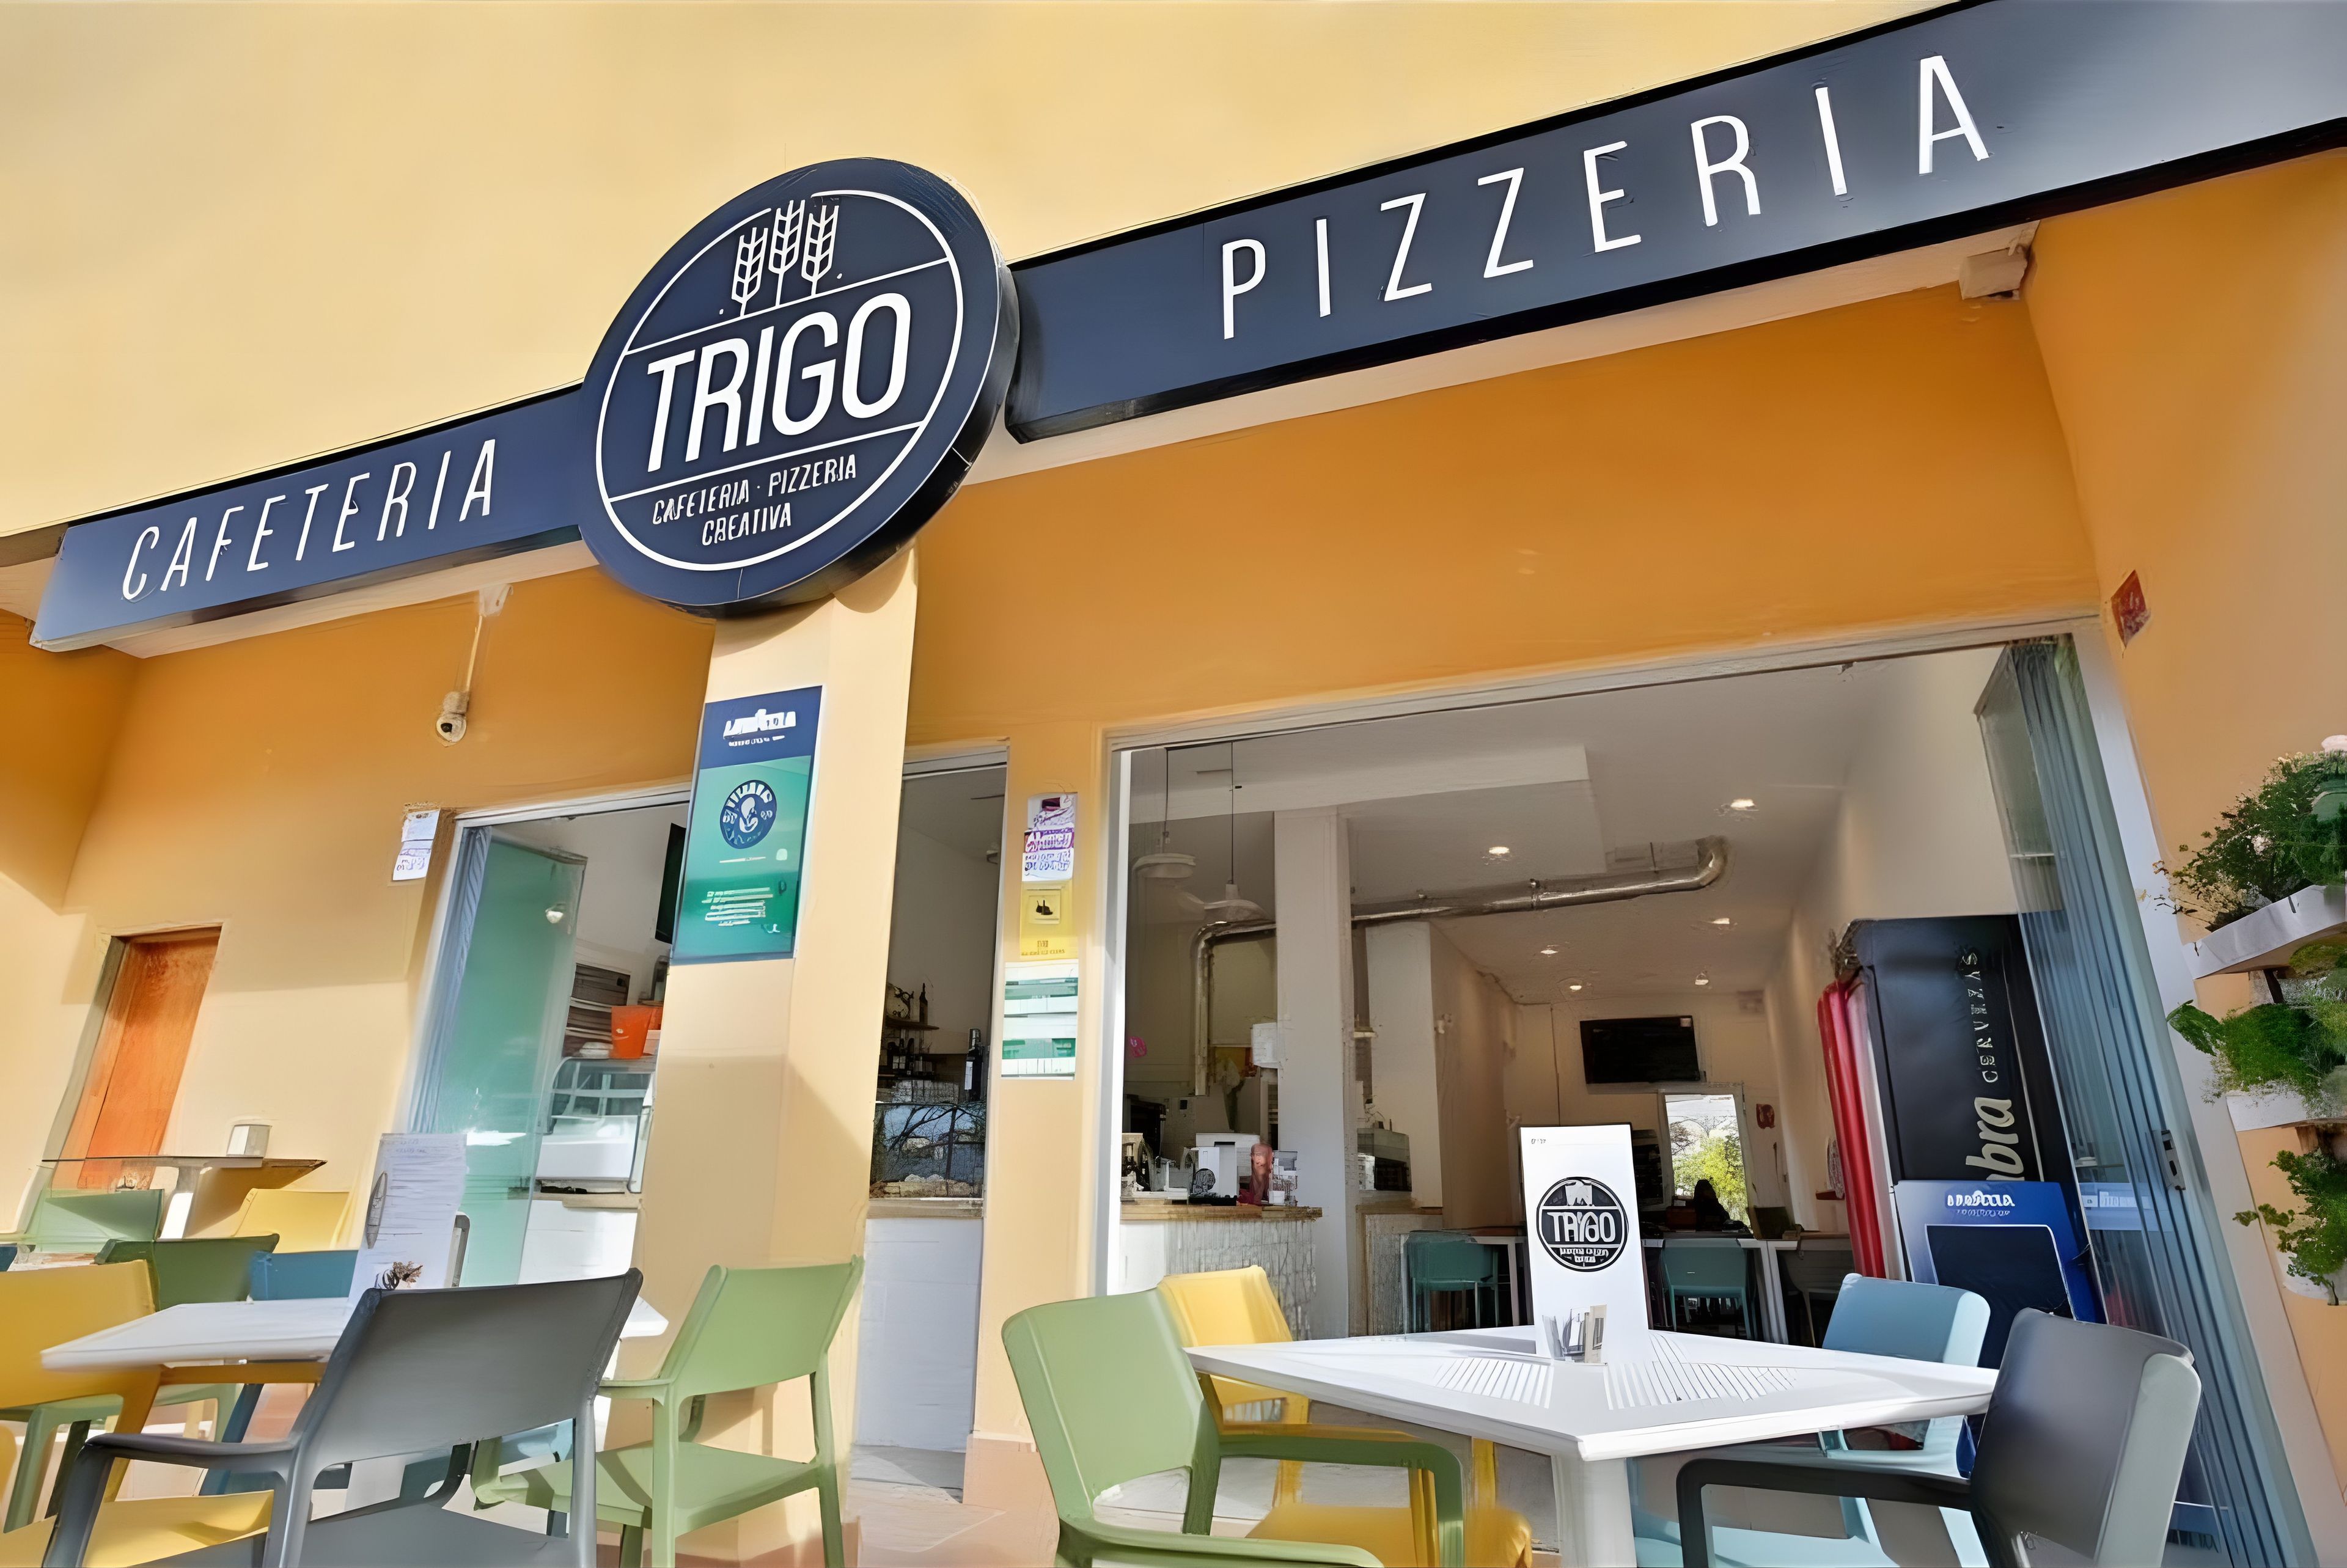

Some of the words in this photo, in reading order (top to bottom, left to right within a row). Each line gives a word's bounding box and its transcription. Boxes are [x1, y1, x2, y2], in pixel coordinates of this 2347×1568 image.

[1222, 55, 1990, 340] PIZZERIA
[647, 292, 911, 473] TRIGO
[122, 438, 496, 601] CAFETERIA
[653, 479, 749, 525] CAFETERIA
[768, 454, 856, 497] PIZZERIA
[702, 502, 792, 546] CREATIVA
